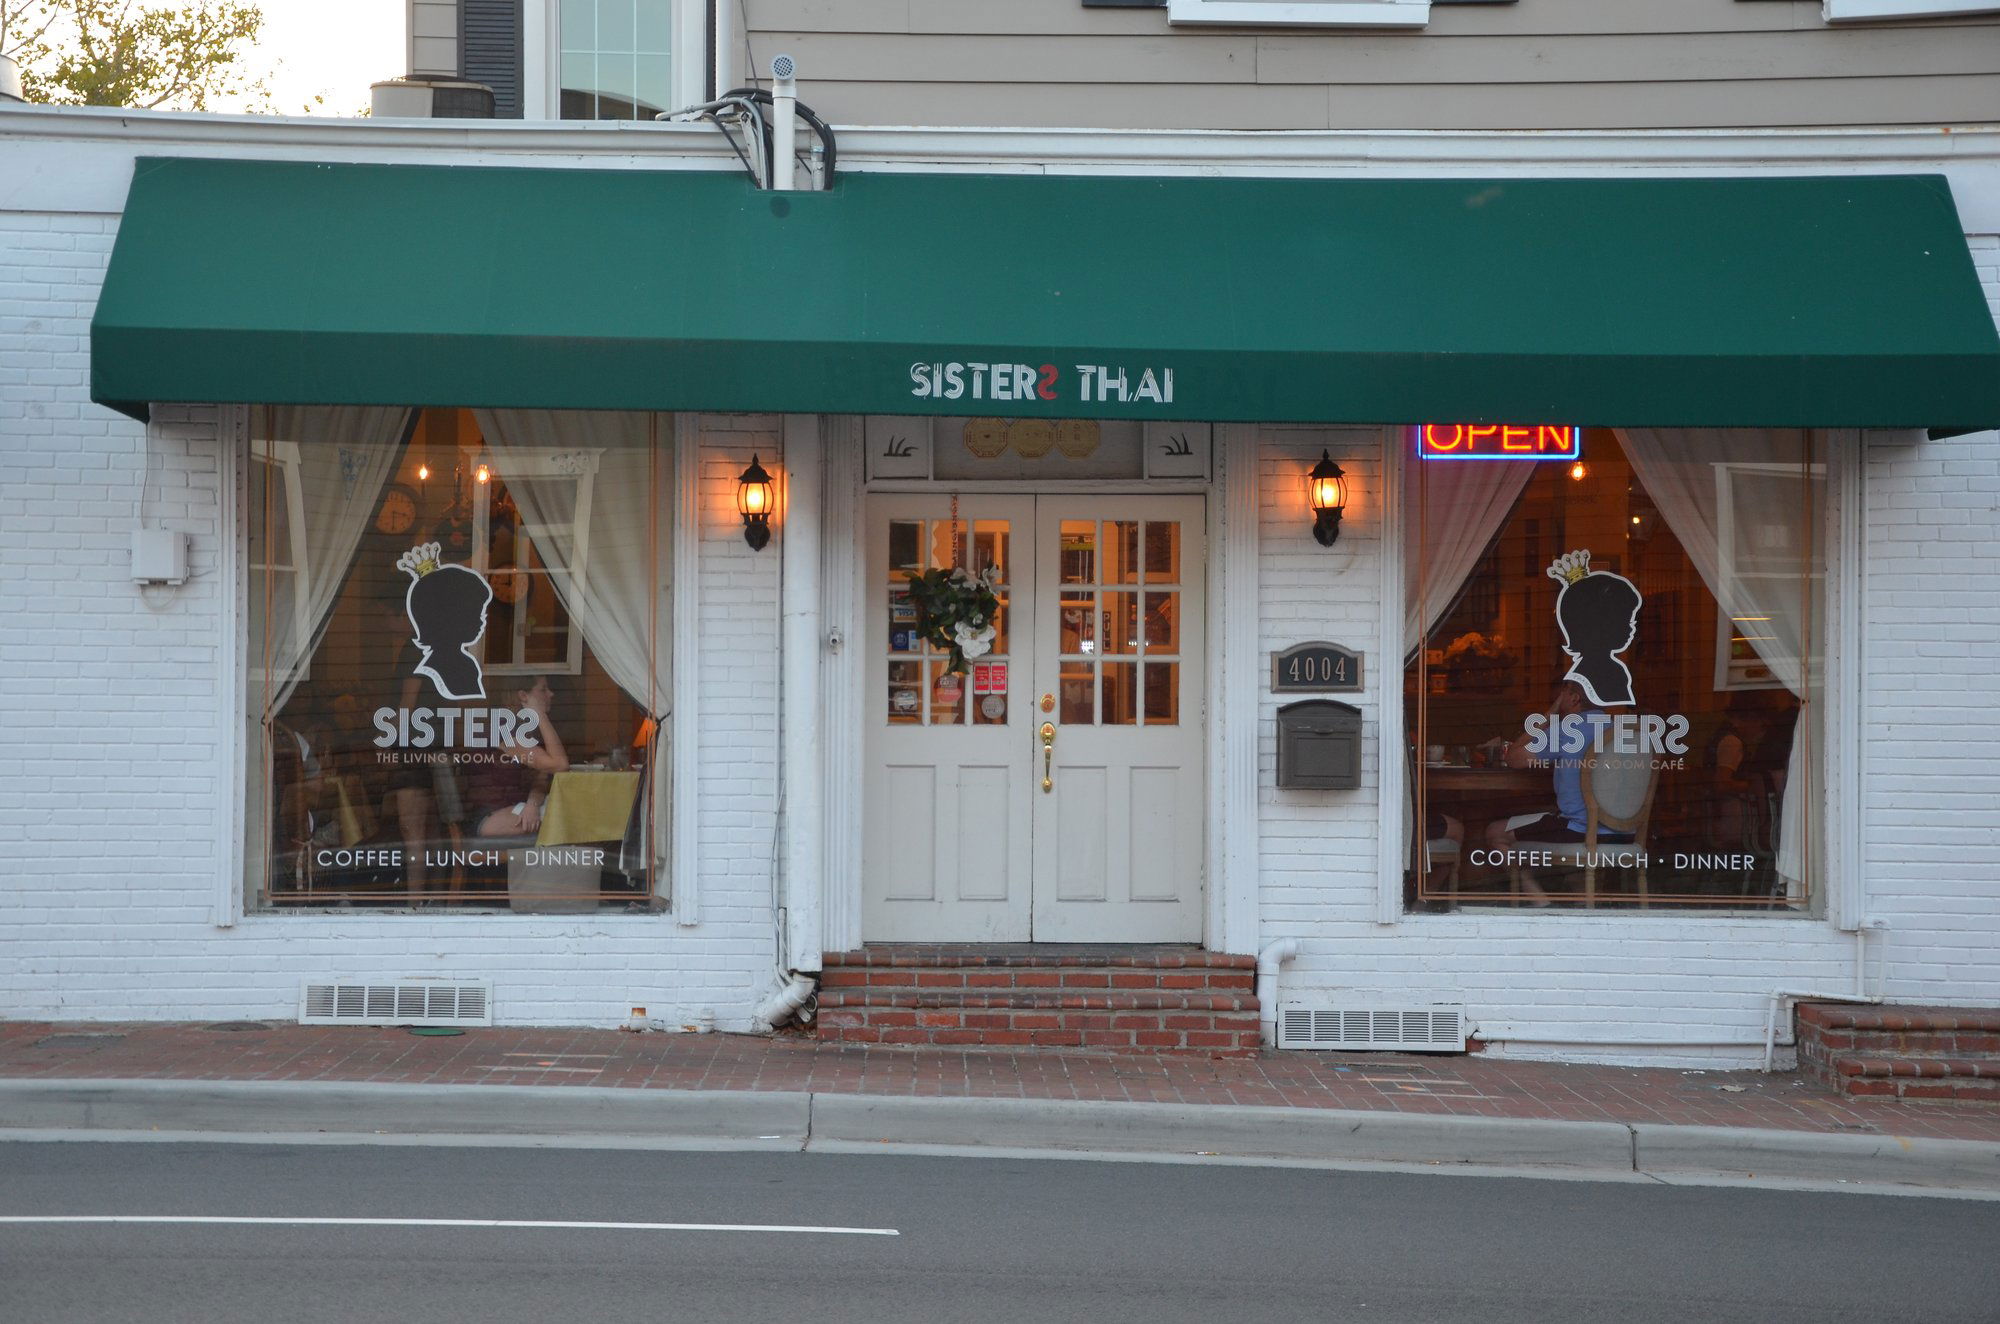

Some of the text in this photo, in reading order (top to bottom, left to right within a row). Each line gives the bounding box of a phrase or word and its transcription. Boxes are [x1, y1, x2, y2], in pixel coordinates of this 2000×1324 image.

[910, 362, 1173, 403] SISTERS THAI
[1426, 425, 1570, 451] OPEN
[1289, 657, 1346, 681] 4004
[373, 706, 540, 748] SISTERS
[1524, 713, 1690, 755] SISTERS
[376, 751, 534, 764] THE LIVING ROOM CAFÉ
[1527, 758, 1550, 769] THE
[1555, 759, 1598, 769] LIVING
[1651, 757, 1685, 770] CAFÉ
[317, 850, 605, 867] COFFEE LUNCH DINNER
[1470, 850, 1755, 870] COFFEE LUNCH DINNER
